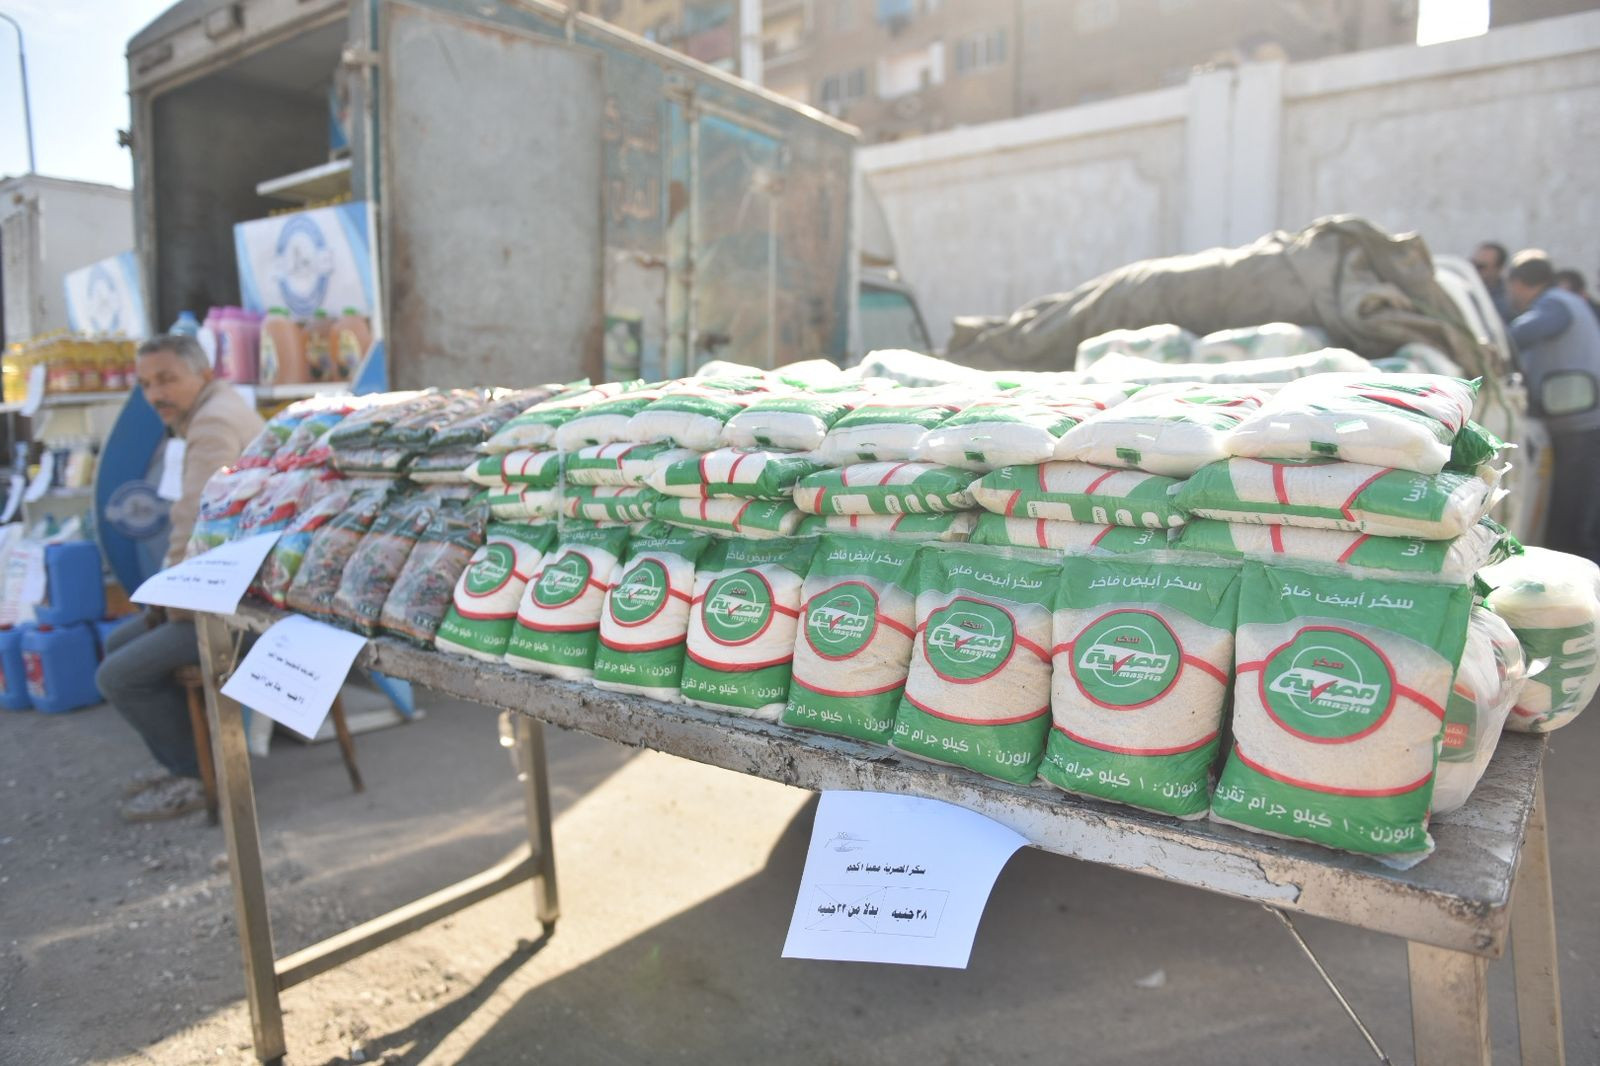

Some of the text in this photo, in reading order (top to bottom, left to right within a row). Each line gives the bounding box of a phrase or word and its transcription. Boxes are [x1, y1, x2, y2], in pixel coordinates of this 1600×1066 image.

[826, 549, 848, 562] فاخر
[875, 554, 904, 567] سكر
[975, 571, 1011, 588] أبيض
[1013, 575, 1043, 590] سكر
[1087, 573, 1202, 592] سكر أبيض فاخر
[1315, 591, 1366, 608] أبيض
[1367, 594, 1414, 610] سكر
[719, 683, 739, 695] كيلو
[758, 686, 784, 699] الوزن
[797, 704, 818, 718] جرام
[1317, 699, 1372, 715] masria
[820, 709, 843, 723] كيلو
[864, 717, 895, 732] الوزن
[911, 728, 939, 748] جرام
[942, 736, 969, 753] كيلو
[995, 750, 1031, 767] الوزن
[1066, 761, 1094, 782] جرام
[1098, 769, 1131, 789] كيلو
[1248, 796, 1287, 818] جرام
[1293, 808, 1333, 828] كيلو
[1370, 826, 1415, 844] الوزن
